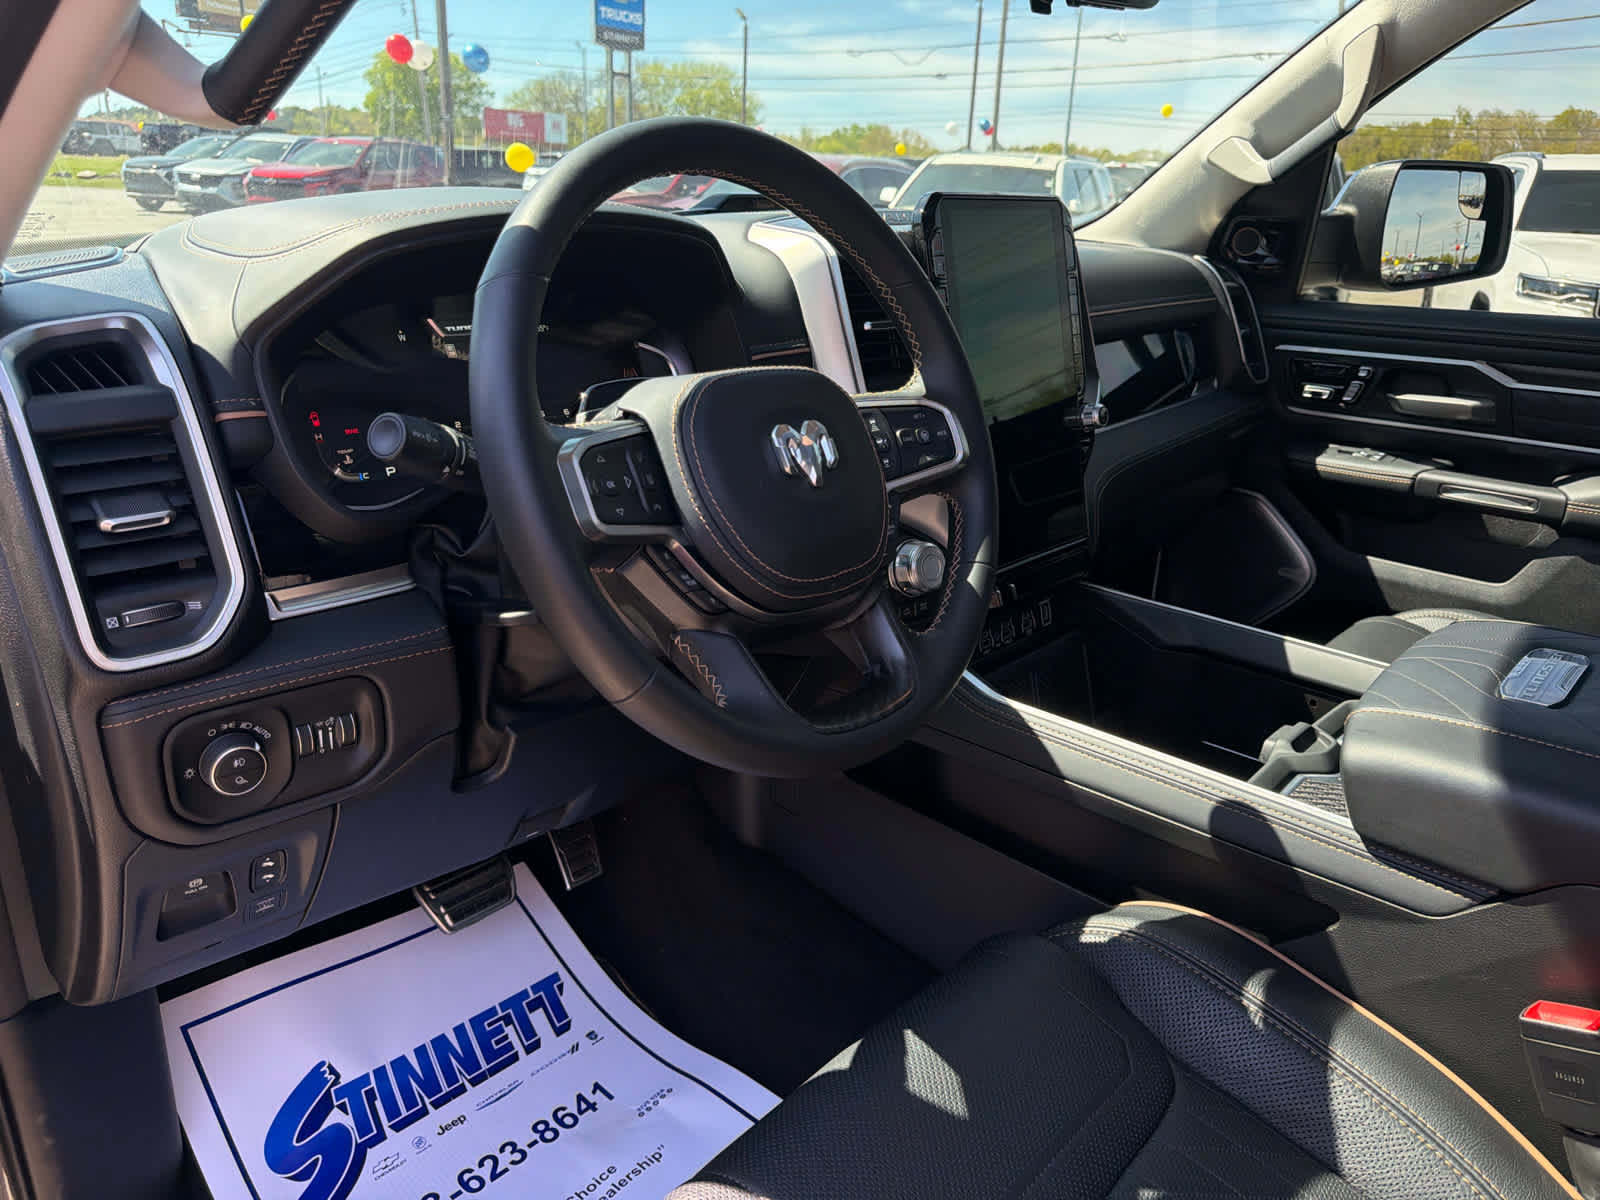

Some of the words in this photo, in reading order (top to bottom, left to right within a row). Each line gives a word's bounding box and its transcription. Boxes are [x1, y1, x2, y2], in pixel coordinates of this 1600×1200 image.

[385, 465, 397, 477] P
[253, 725, 272, 739] AUTO
[264, 971, 572, 1200] STINNETT
[437, 1113, 467, 1136] Jeep
[420, 1081, 616, 1200] -623-8641
